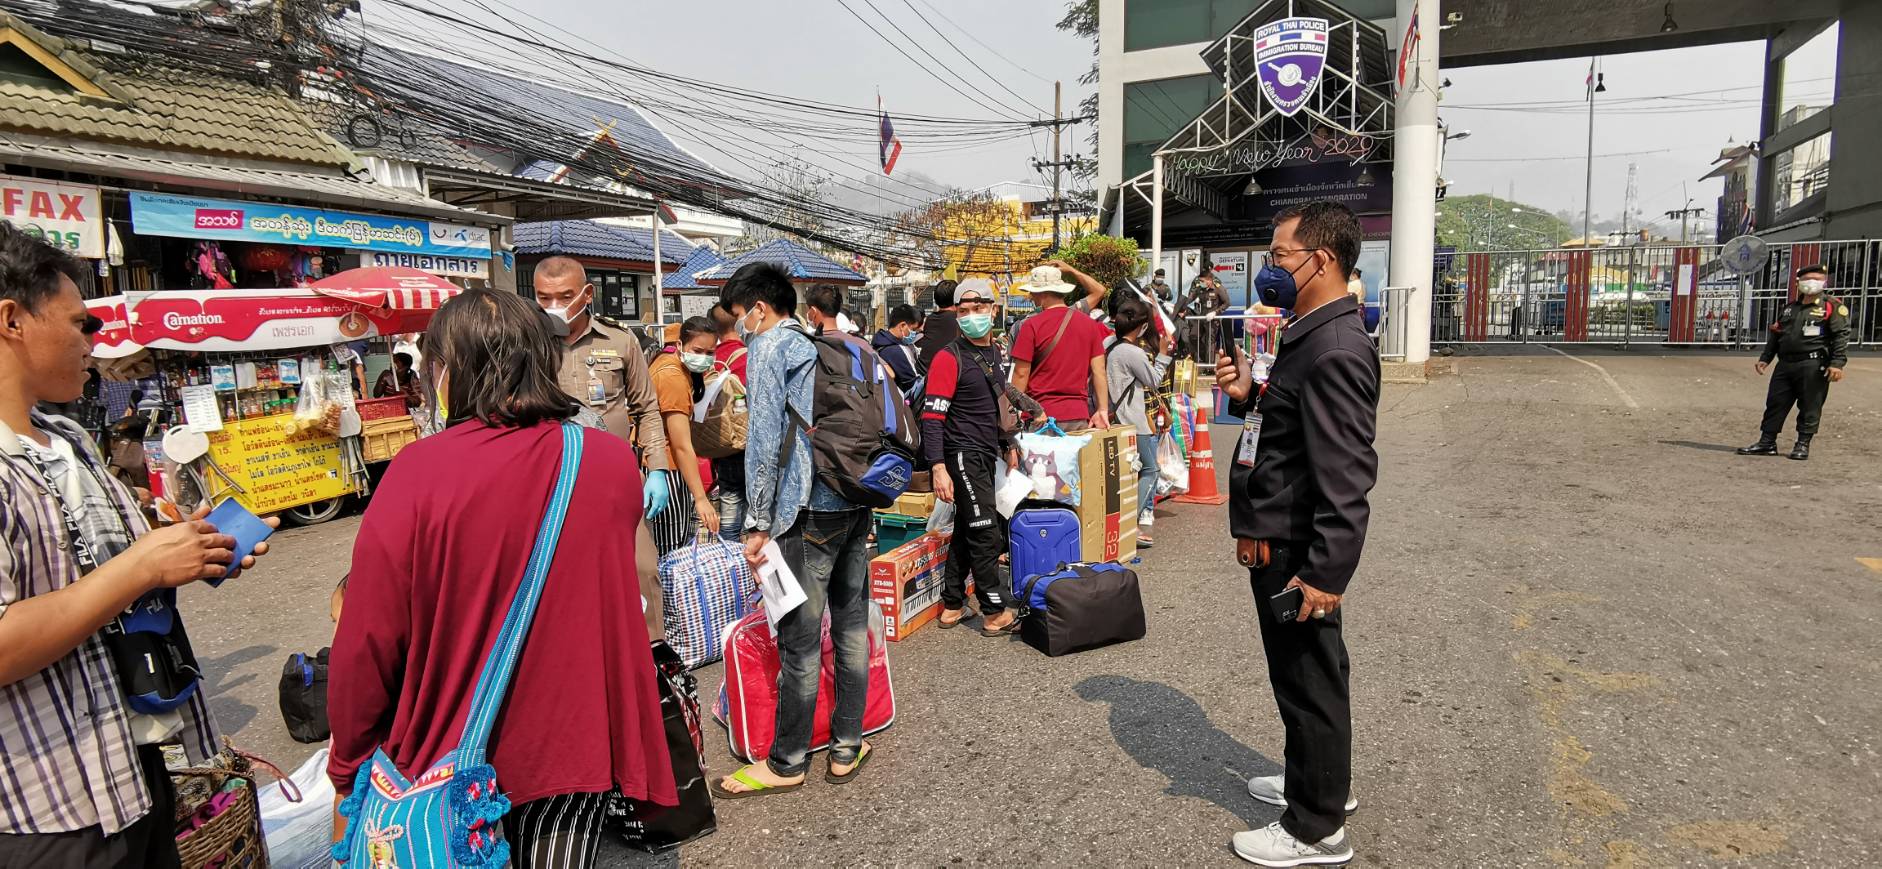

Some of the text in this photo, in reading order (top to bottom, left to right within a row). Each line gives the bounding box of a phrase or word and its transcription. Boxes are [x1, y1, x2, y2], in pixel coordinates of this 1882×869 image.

[1258, 21, 1325, 38] ROYAL THAI POLICE
[1258, 43, 1324, 59] IMMIGRATION BUREAU
[1171, 135, 1374, 175] Happy New Year 2020
[3, 188, 86, 222] FAX
[163, 311, 225, 330] Carnation
[1107, 440, 1116, 477] LED TV
[61, 503, 78, 532] FILA
[73, 536, 93, 567] FILA
[1105, 530, 1118, 556] 32
